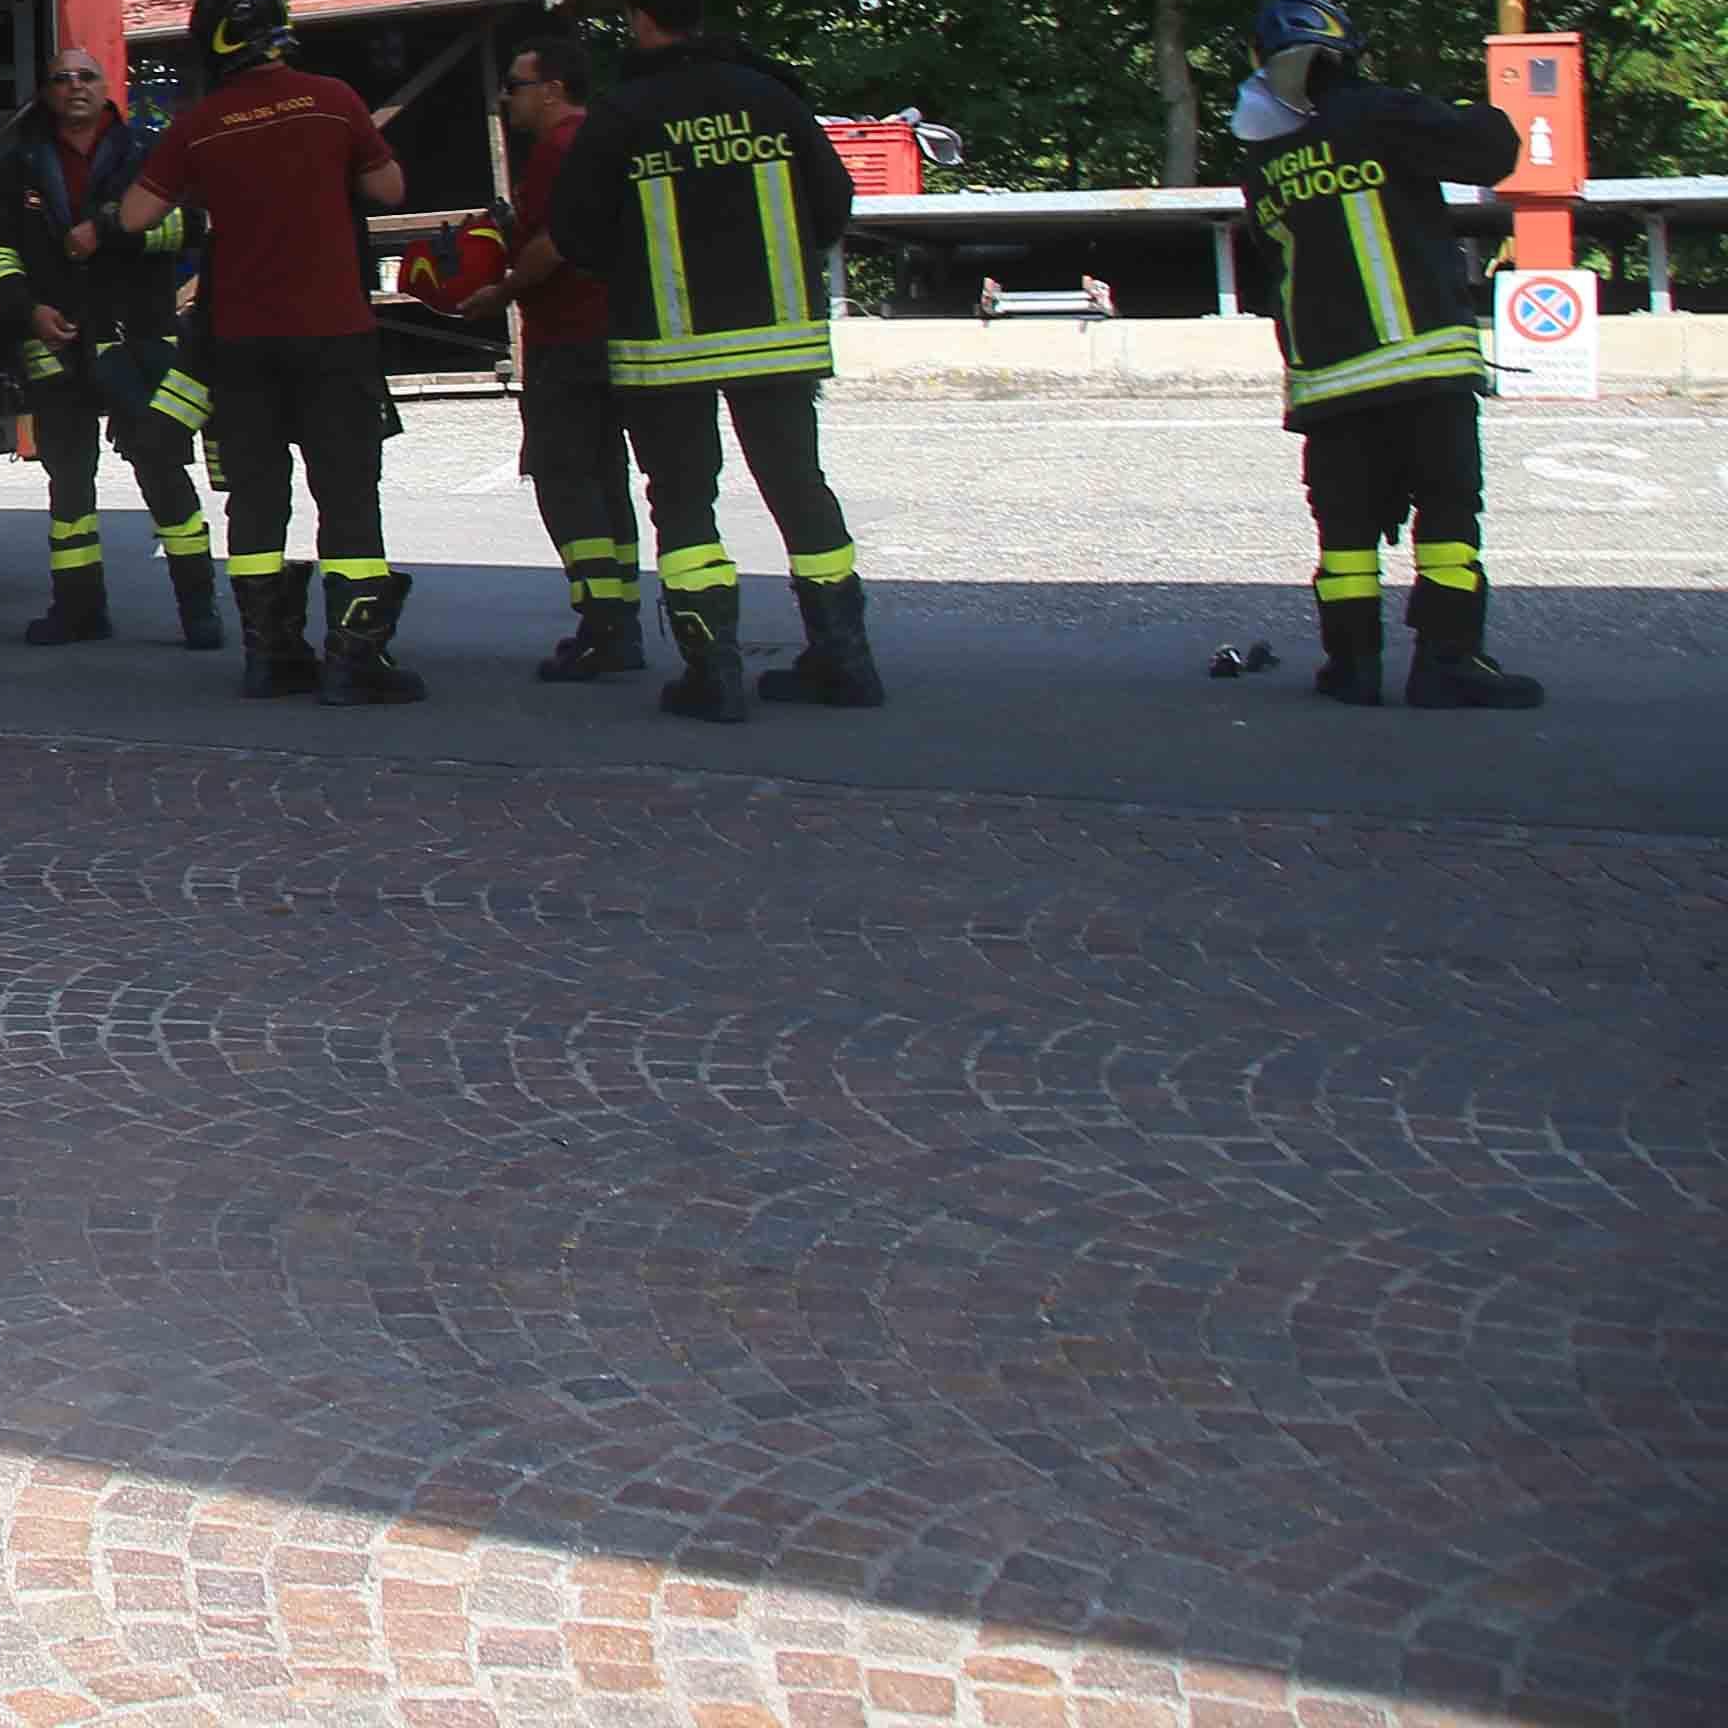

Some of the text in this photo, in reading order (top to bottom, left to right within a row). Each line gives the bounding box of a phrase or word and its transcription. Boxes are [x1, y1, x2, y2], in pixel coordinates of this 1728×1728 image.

[663, 110, 753, 145] VIGILI
[627, 150, 685, 180] DEL
[1260, 140, 1332, 185] VIGILI
[1255, 159, 1386, 225] EL FUOCO
